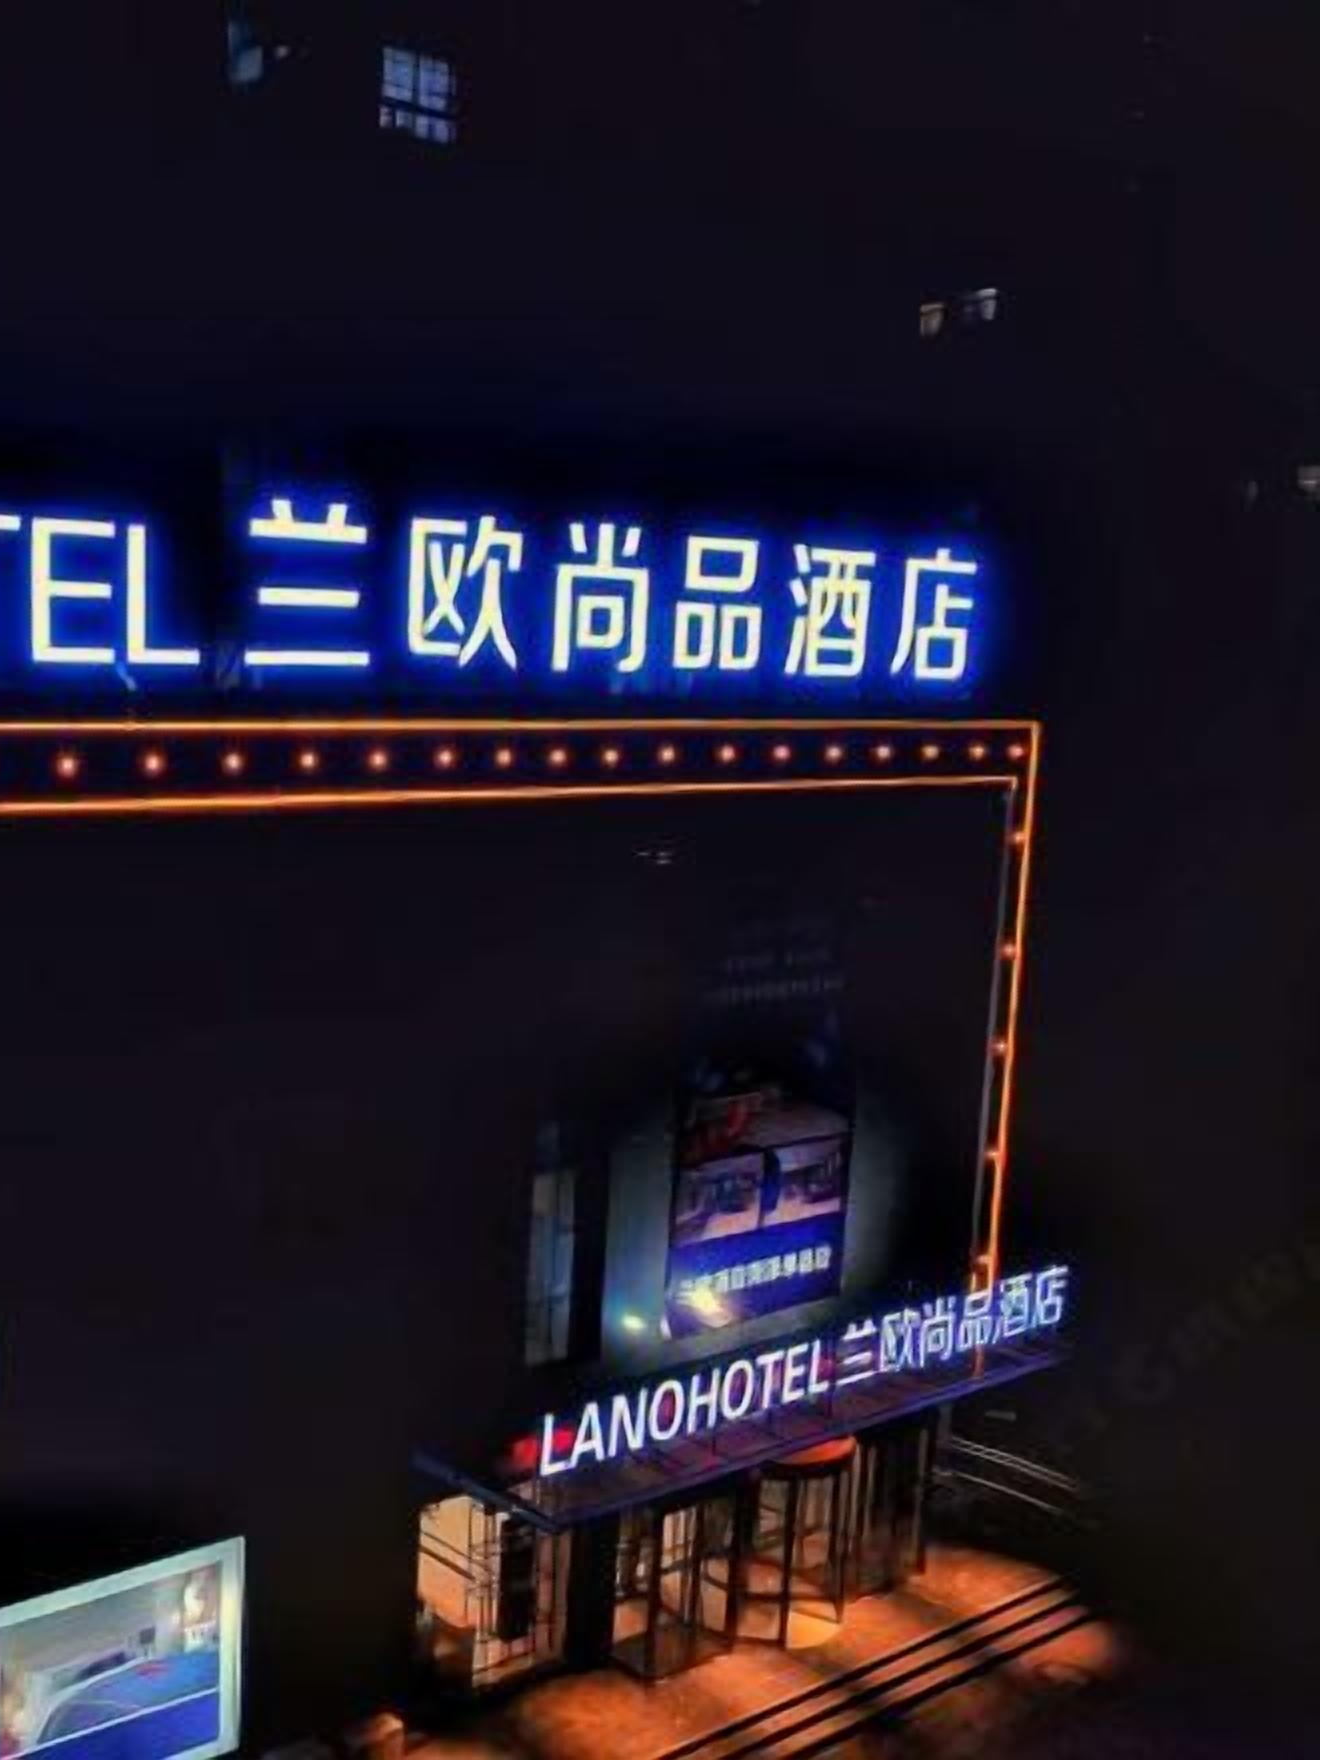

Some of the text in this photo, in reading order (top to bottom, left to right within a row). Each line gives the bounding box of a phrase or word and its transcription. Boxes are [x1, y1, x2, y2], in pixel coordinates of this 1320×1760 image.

[244, 498, 978, 680] 兰欧尚品酒店
[539, 1338, 830, 1477] LANOHOTEL
[835, 1264, 1069, 1386] 兰欧尚品酒店
